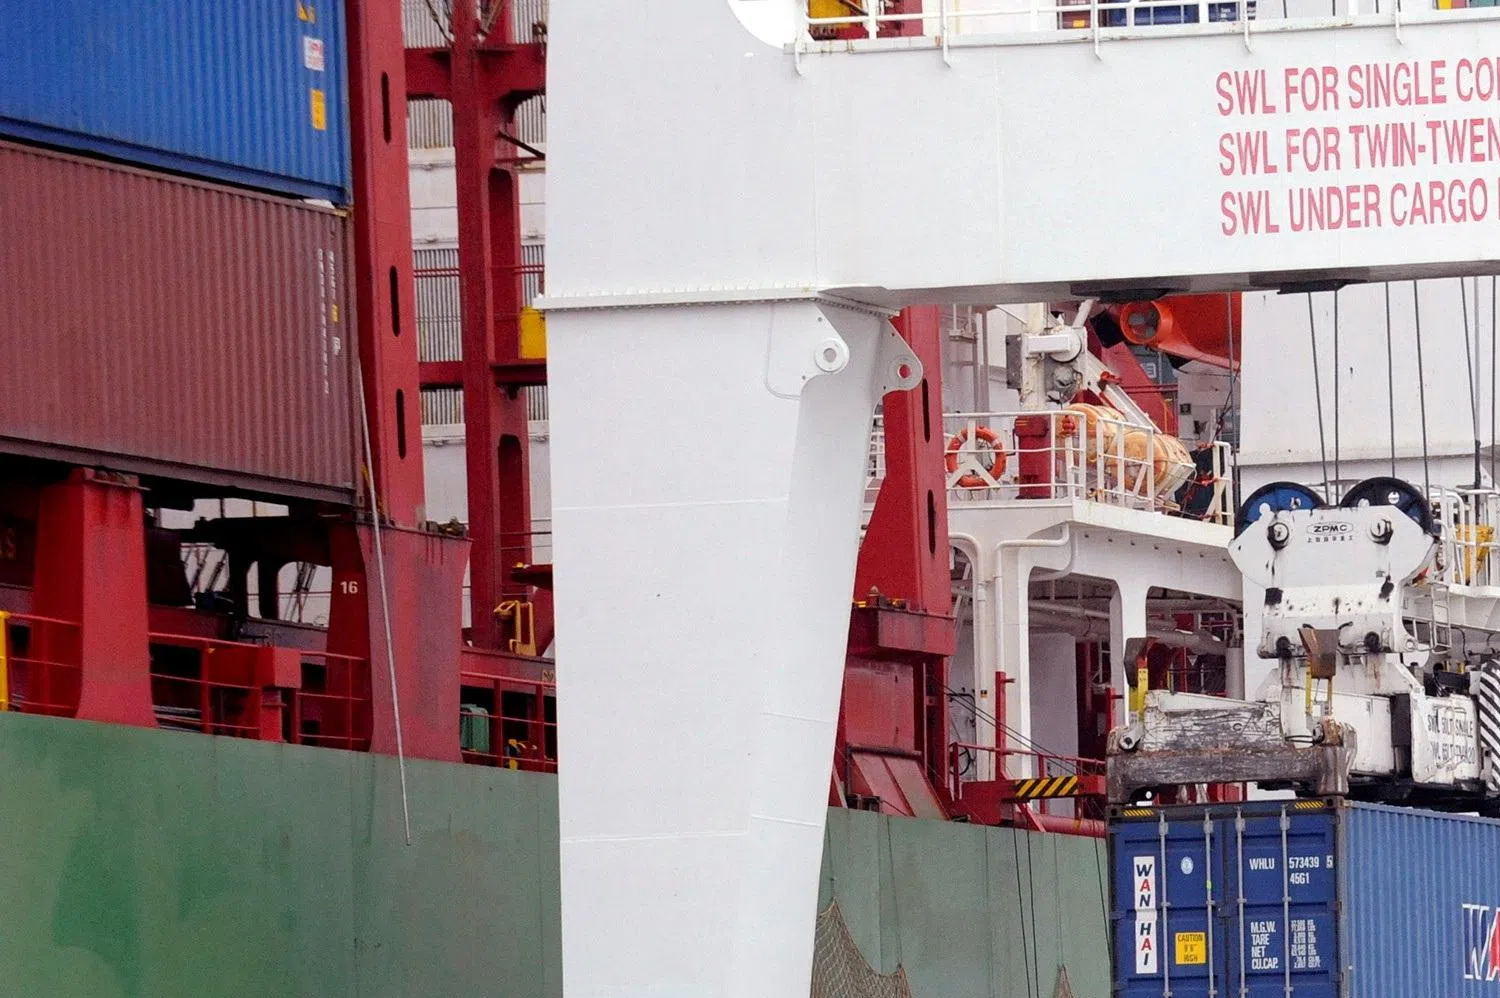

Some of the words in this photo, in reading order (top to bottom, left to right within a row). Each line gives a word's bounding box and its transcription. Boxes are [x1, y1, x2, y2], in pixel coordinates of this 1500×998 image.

[1216, 70, 1276, 116] SWL
[1284, 66, 1339, 113] FOR
[1348, 60, 1448, 109] SINGLE
[1219, 131, 1278, 176] SWL
[1286, 126, 1340, 173] FOR
[1221, 190, 1280, 237] SWL
[1289, 184, 1381, 233] UNDER
[1390, 177, 1488, 226] CARGO
[340, 581, 358, 594] 16
[1249, 858, 1275, 870] WHLU
[1289, 857, 1319, 869] 573439
[1326, 855, 1333, 869] 5
[1136, 864, 1152, 907] WAN
[1289, 872, 1309, 885] 45G1
[1140, 923, 1152, 966] HAI
[1177, 933, 1204, 942] CAUTION
[1251, 934, 1270, 945] TARE
[1183, 953, 1198, 962] HIGH
[1252, 946, 1265, 957] NET
